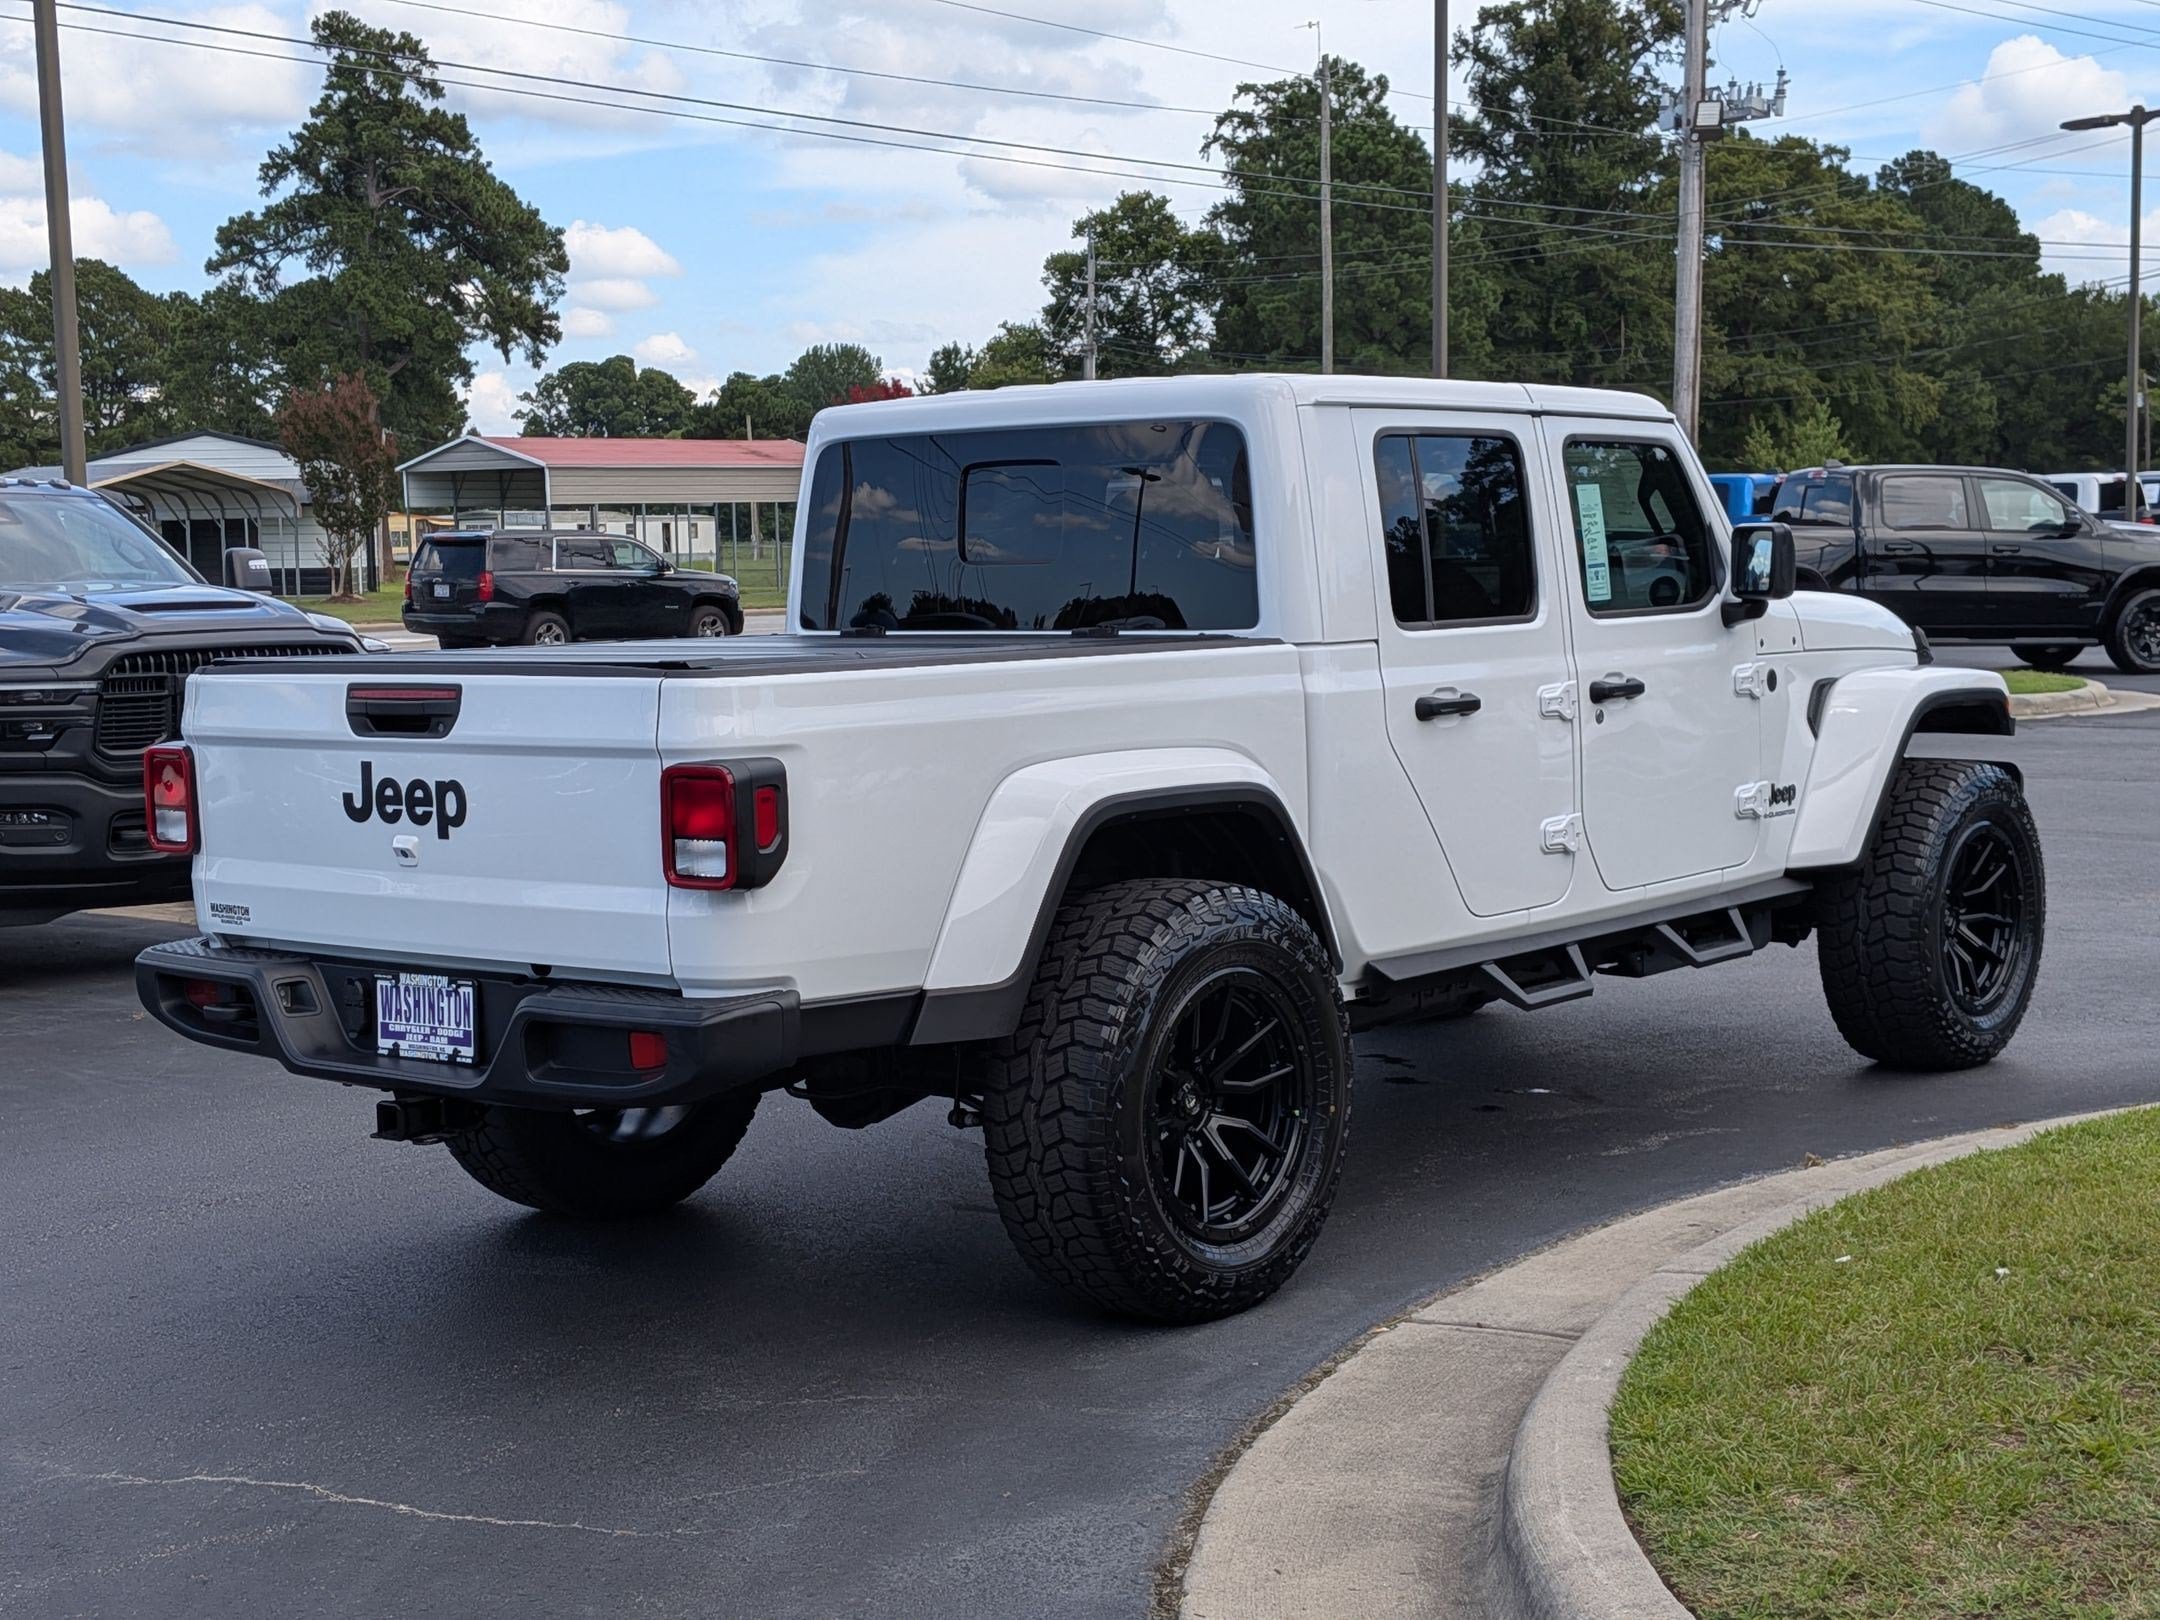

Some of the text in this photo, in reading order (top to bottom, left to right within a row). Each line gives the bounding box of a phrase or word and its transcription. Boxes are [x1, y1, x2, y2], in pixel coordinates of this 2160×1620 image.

[343, 761, 467, 840] Jeep
[1768, 783, 1797, 807] Jeep
[210, 902, 249, 916] WASHINGTON
[399, 973, 448, 988] WASHINGTON
[380, 984, 472, 1029] WASHINGTON
[388, 1024, 464, 1038] CHRYSLER DODGE
[405, 1033, 448, 1045] JEEP RAM
